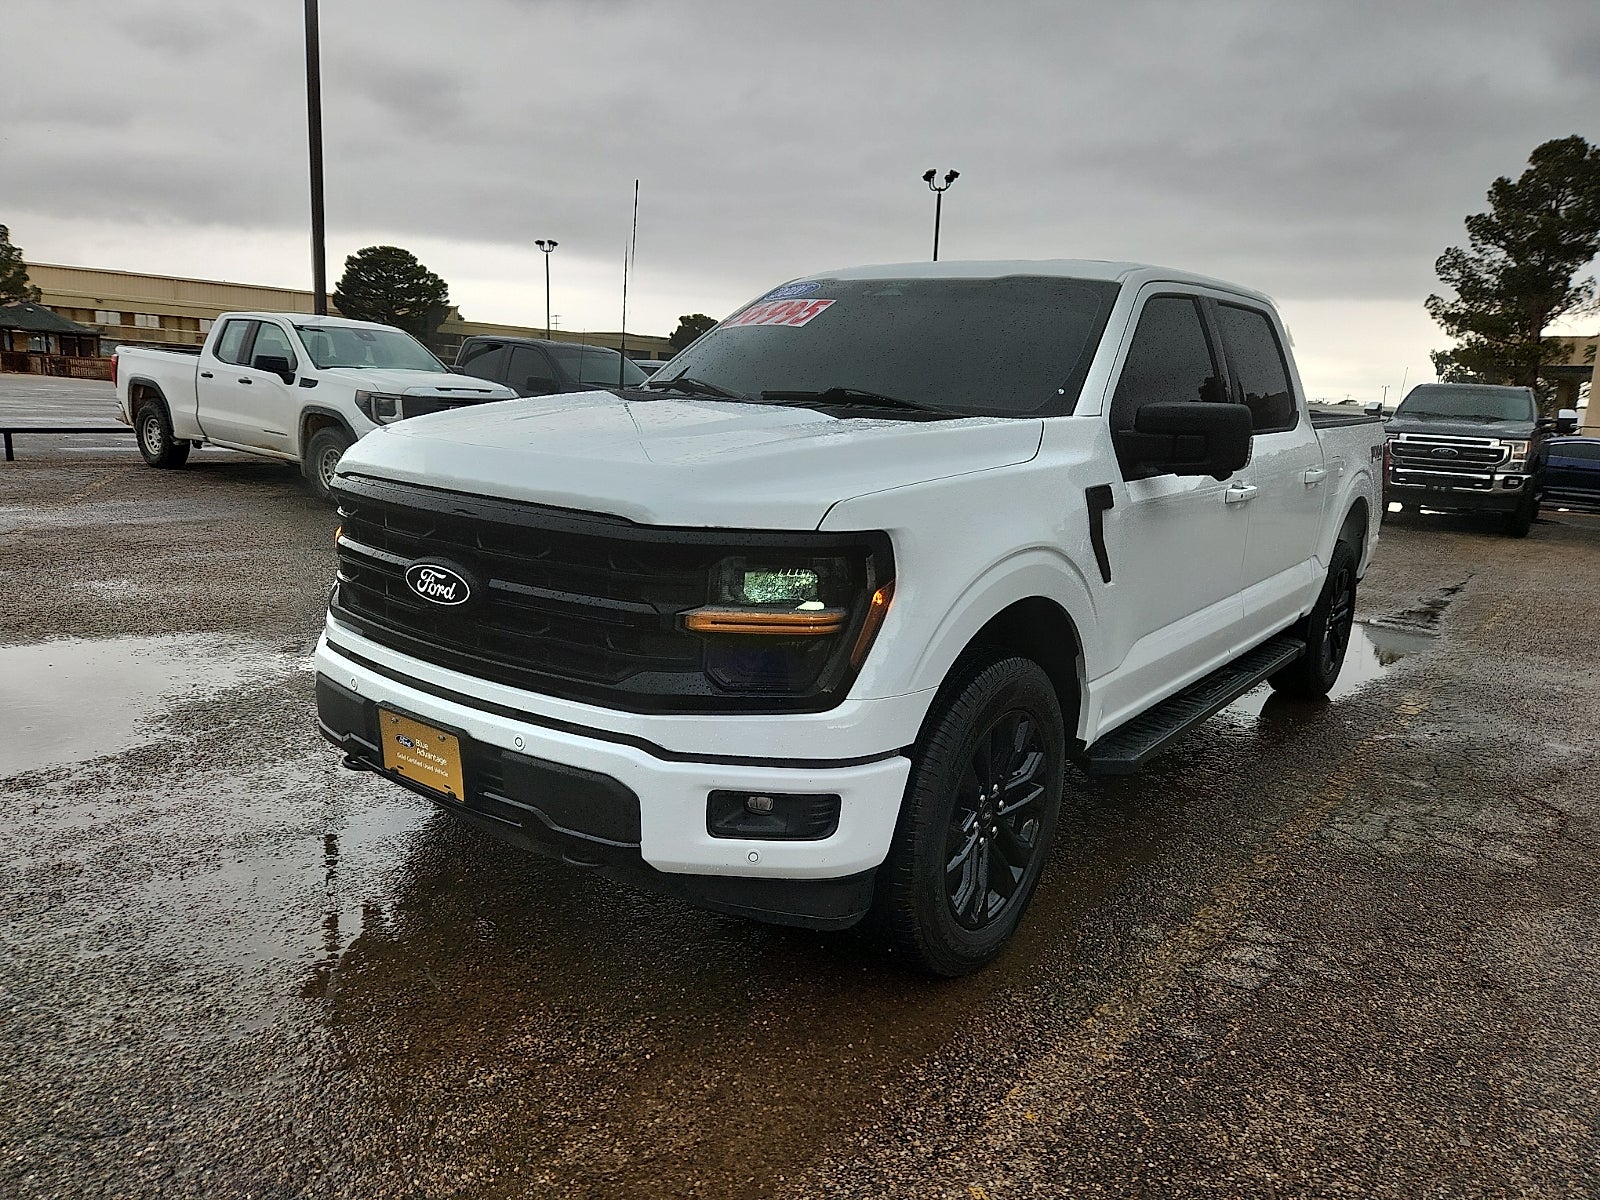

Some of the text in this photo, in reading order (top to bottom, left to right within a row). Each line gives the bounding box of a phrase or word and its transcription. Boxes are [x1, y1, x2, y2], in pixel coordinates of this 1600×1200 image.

[417, 569, 457, 600] Ford
[415, 739, 429, 750] Blue
[416, 748, 448, 766] Advantage
